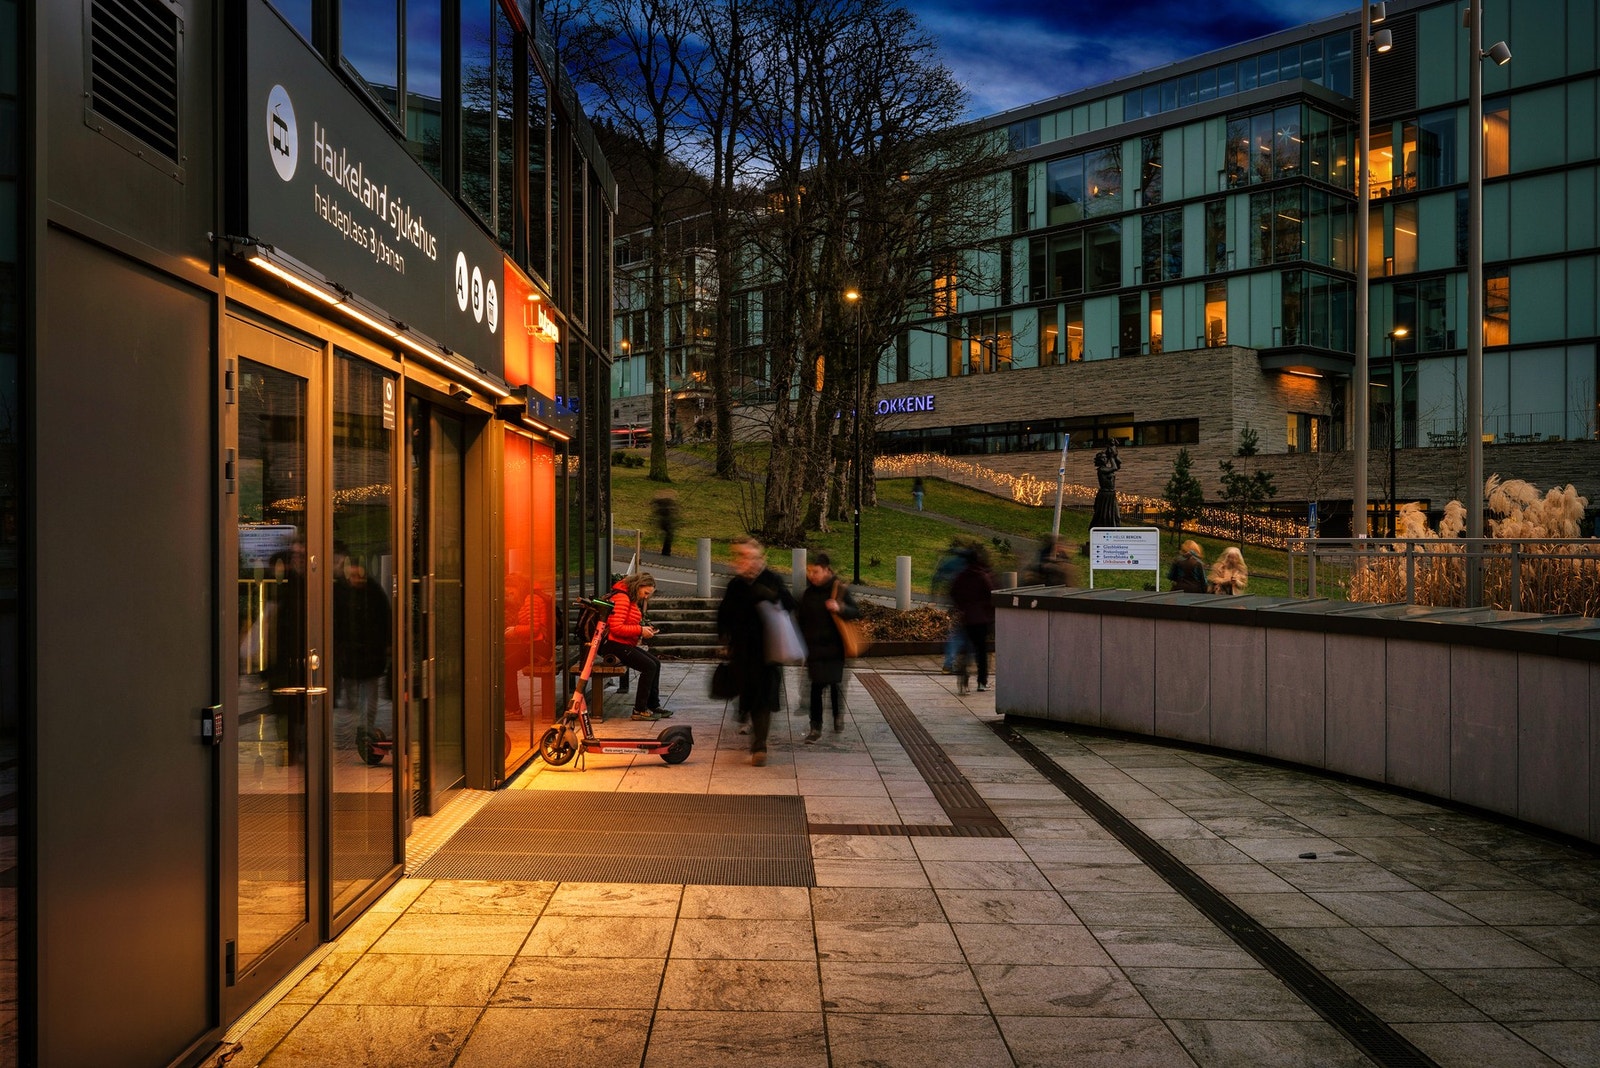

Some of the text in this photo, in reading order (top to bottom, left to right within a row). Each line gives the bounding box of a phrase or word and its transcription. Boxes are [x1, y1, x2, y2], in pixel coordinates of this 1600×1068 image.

[314, 121, 437, 261] Haukeland sjukehus
[314, 184, 405, 275] haldeplass Bybanen
[456, 266, 464, 300] A
[474, 279, 479, 311] B
